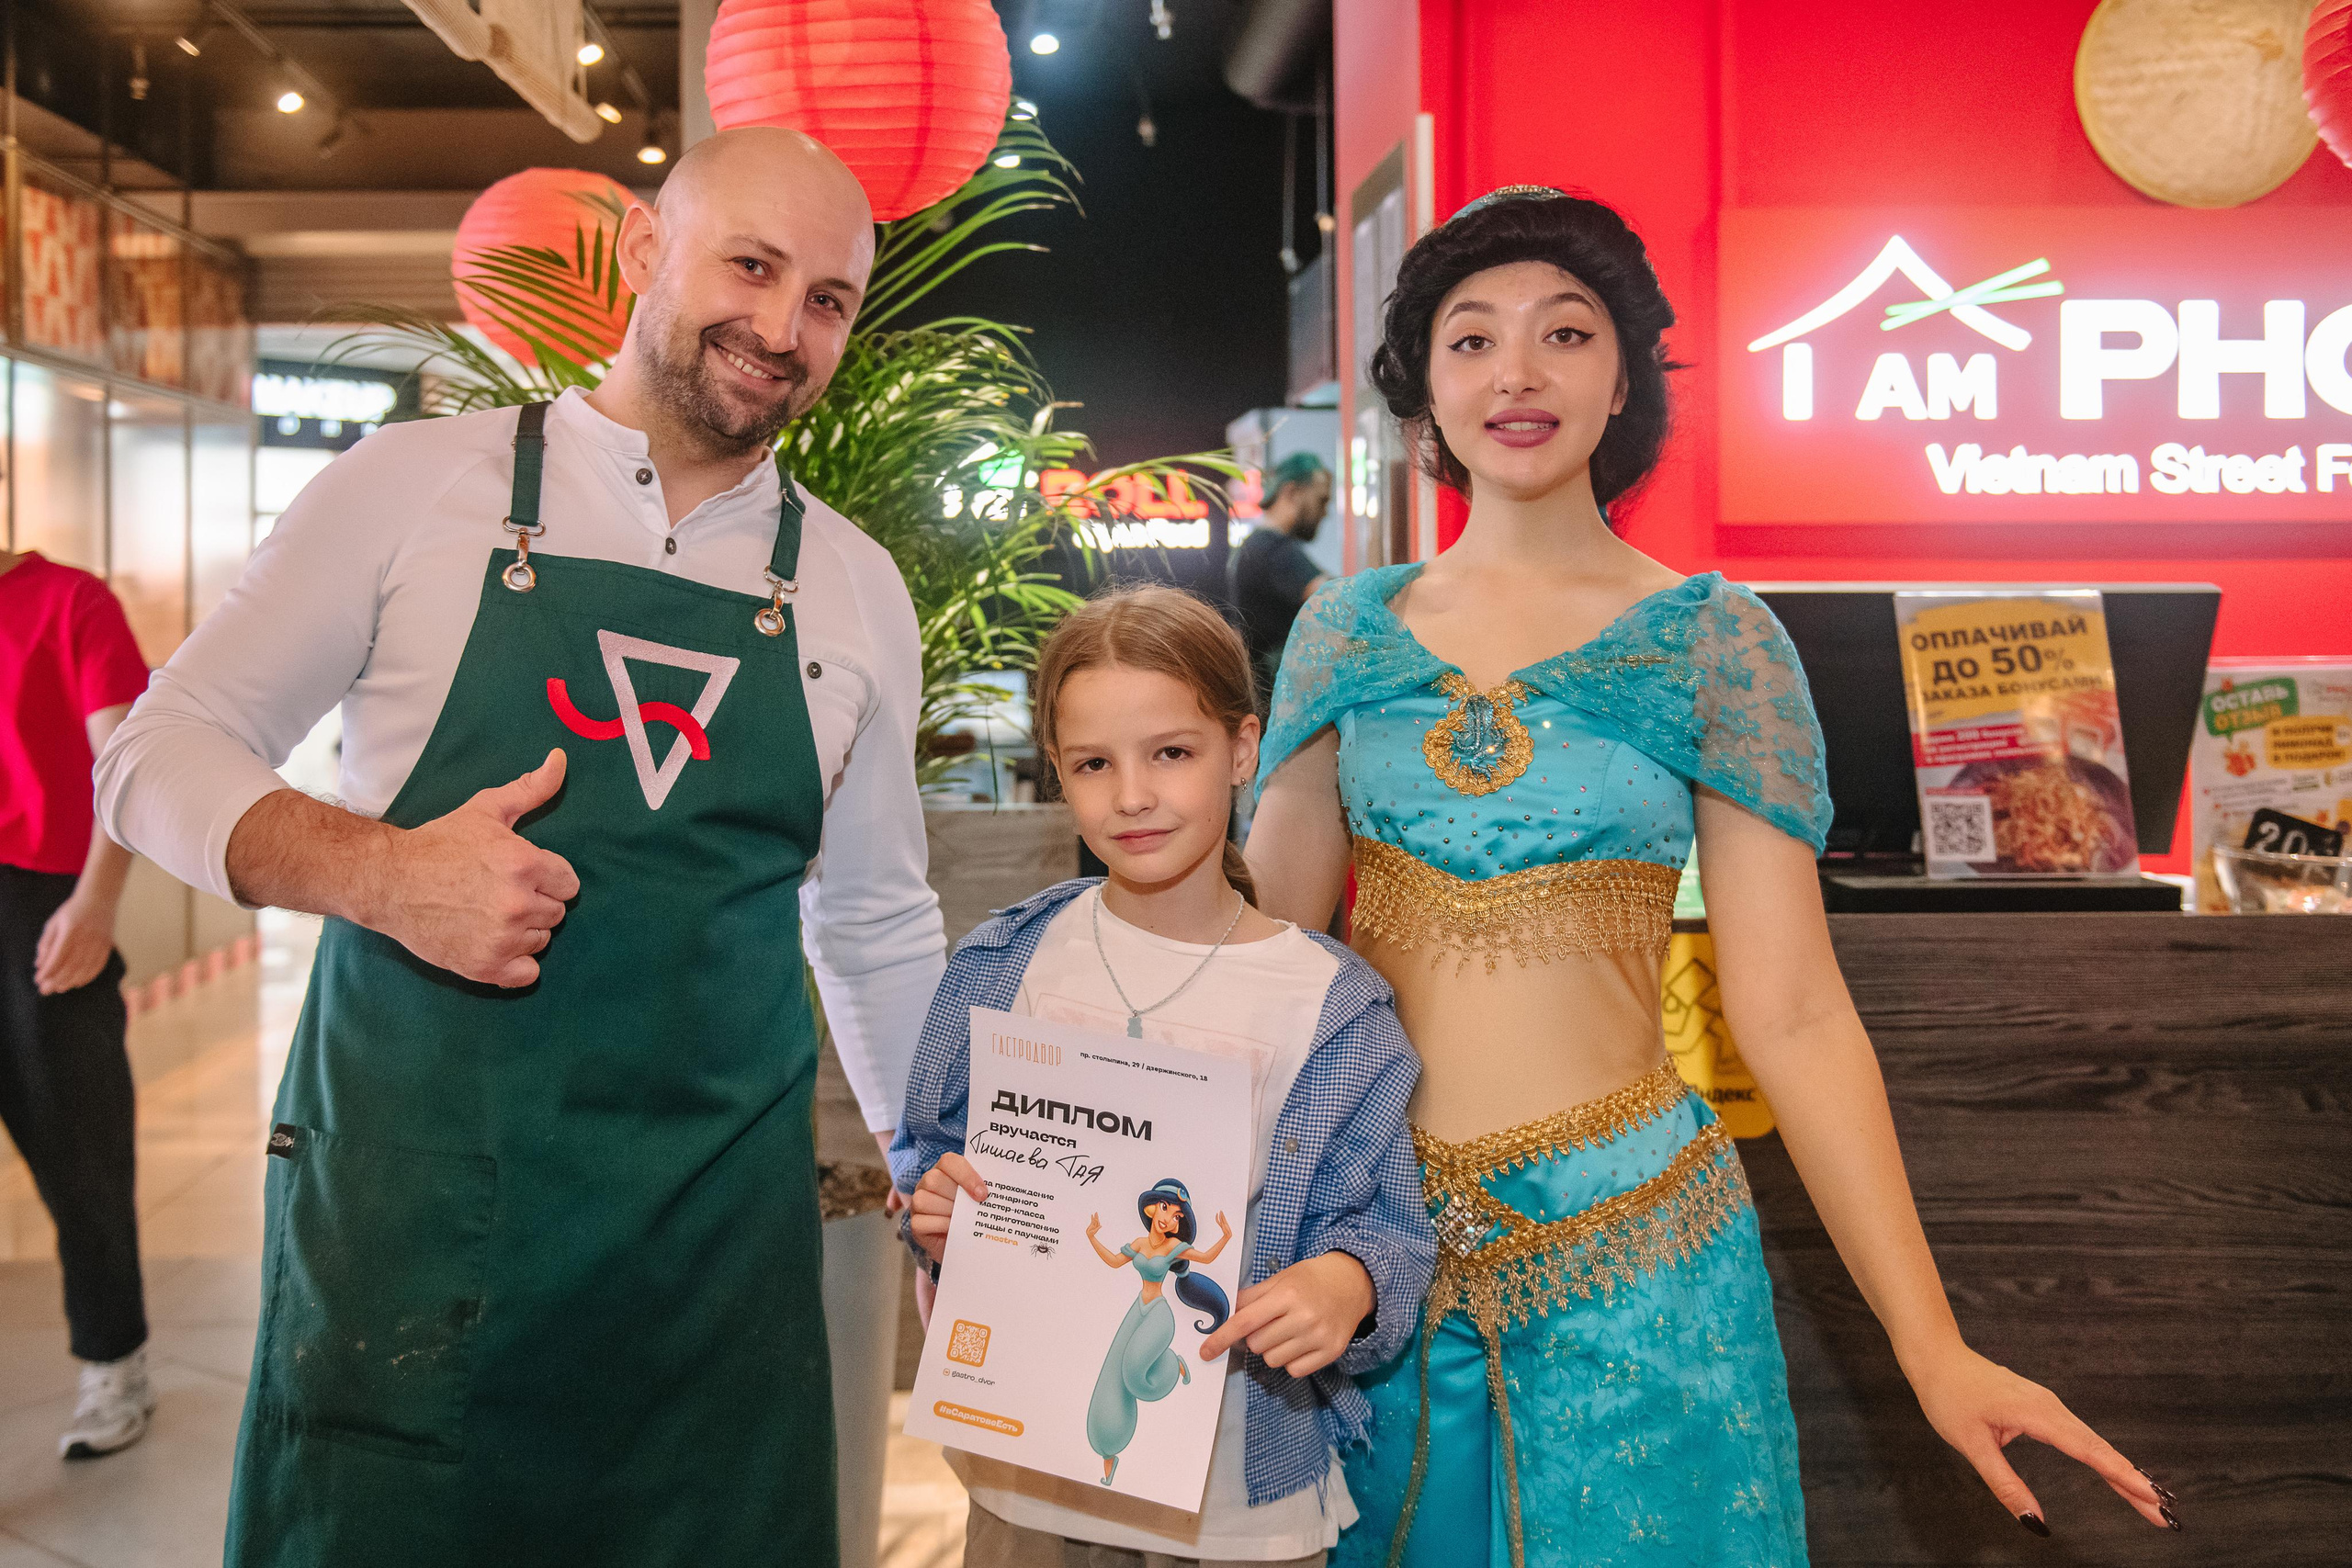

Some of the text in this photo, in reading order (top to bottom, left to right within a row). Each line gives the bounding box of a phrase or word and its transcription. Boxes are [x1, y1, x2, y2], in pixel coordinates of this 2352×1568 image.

[1782, 343, 1815, 422] I
[1854, 352, 1998, 421] AM
[1925, 442, 2140, 494] Vietnam
[2149, 442, 2307, 494] Street
[1910, 613, 2088, 651] ОПЛАЧИВАЙ
[1932, 644, 2075, 686] ДО 50%
[2211, 685, 2290, 713] ОСТАВЬ
[992, 1032, 1062, 1066] ГАСТРОДВОР
[1080, 1051, 1091, 1060] пр.
[1091, 1054, 1131, 1068] столыпина,
[1132, 1061, 1141, 1069] 29
[1146, 1065, 1200, 1082] дзержинского,
[1200, 1074, 1209, 1083] 18
[1695, 1086, 1756, 1105] ндекс
[990, 1089, 1153, 1142] ДИПЛОМ
[989, 1122, 1078, 1149] вручается
[987, 1191, 1040, 1208] улинарного
[994, 1182, 1056, 1201] прохождение
[974, 1220, 1007, 1234] пиццы
[1013, 1229, 1060, 1246] паучками
[977, 1210, 1060, 1235] по приготовлению
[985, 1234, 1019, 1247] mostra
[951, 1370, 996, 1386] gastro_dvor
[939, 1404, 1019, 1433] #вСаратовеЕсть
